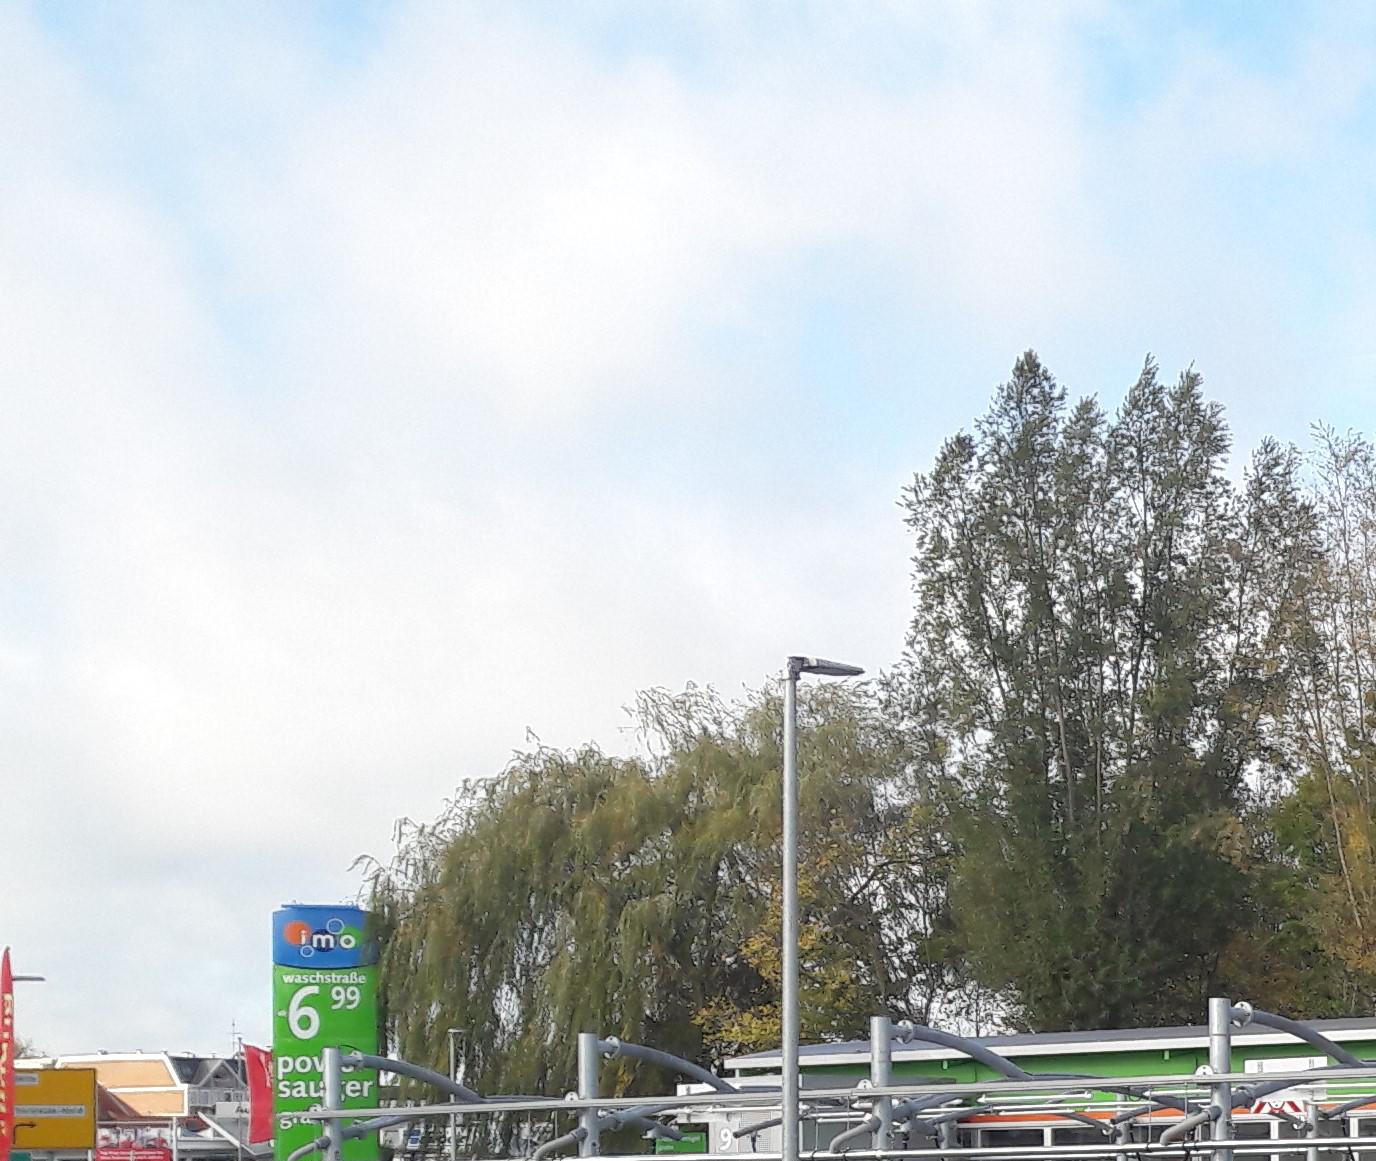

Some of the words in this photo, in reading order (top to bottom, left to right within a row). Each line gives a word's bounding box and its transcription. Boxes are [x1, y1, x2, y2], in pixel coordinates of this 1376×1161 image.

[301, 930, 355, 949] imo
[282, 971, 367, 984] waschstraße
[288, 985, 320, 1040] 6
[331, 985, 360, 1010] 99
[278, 1080, 373, 1101] sauer
